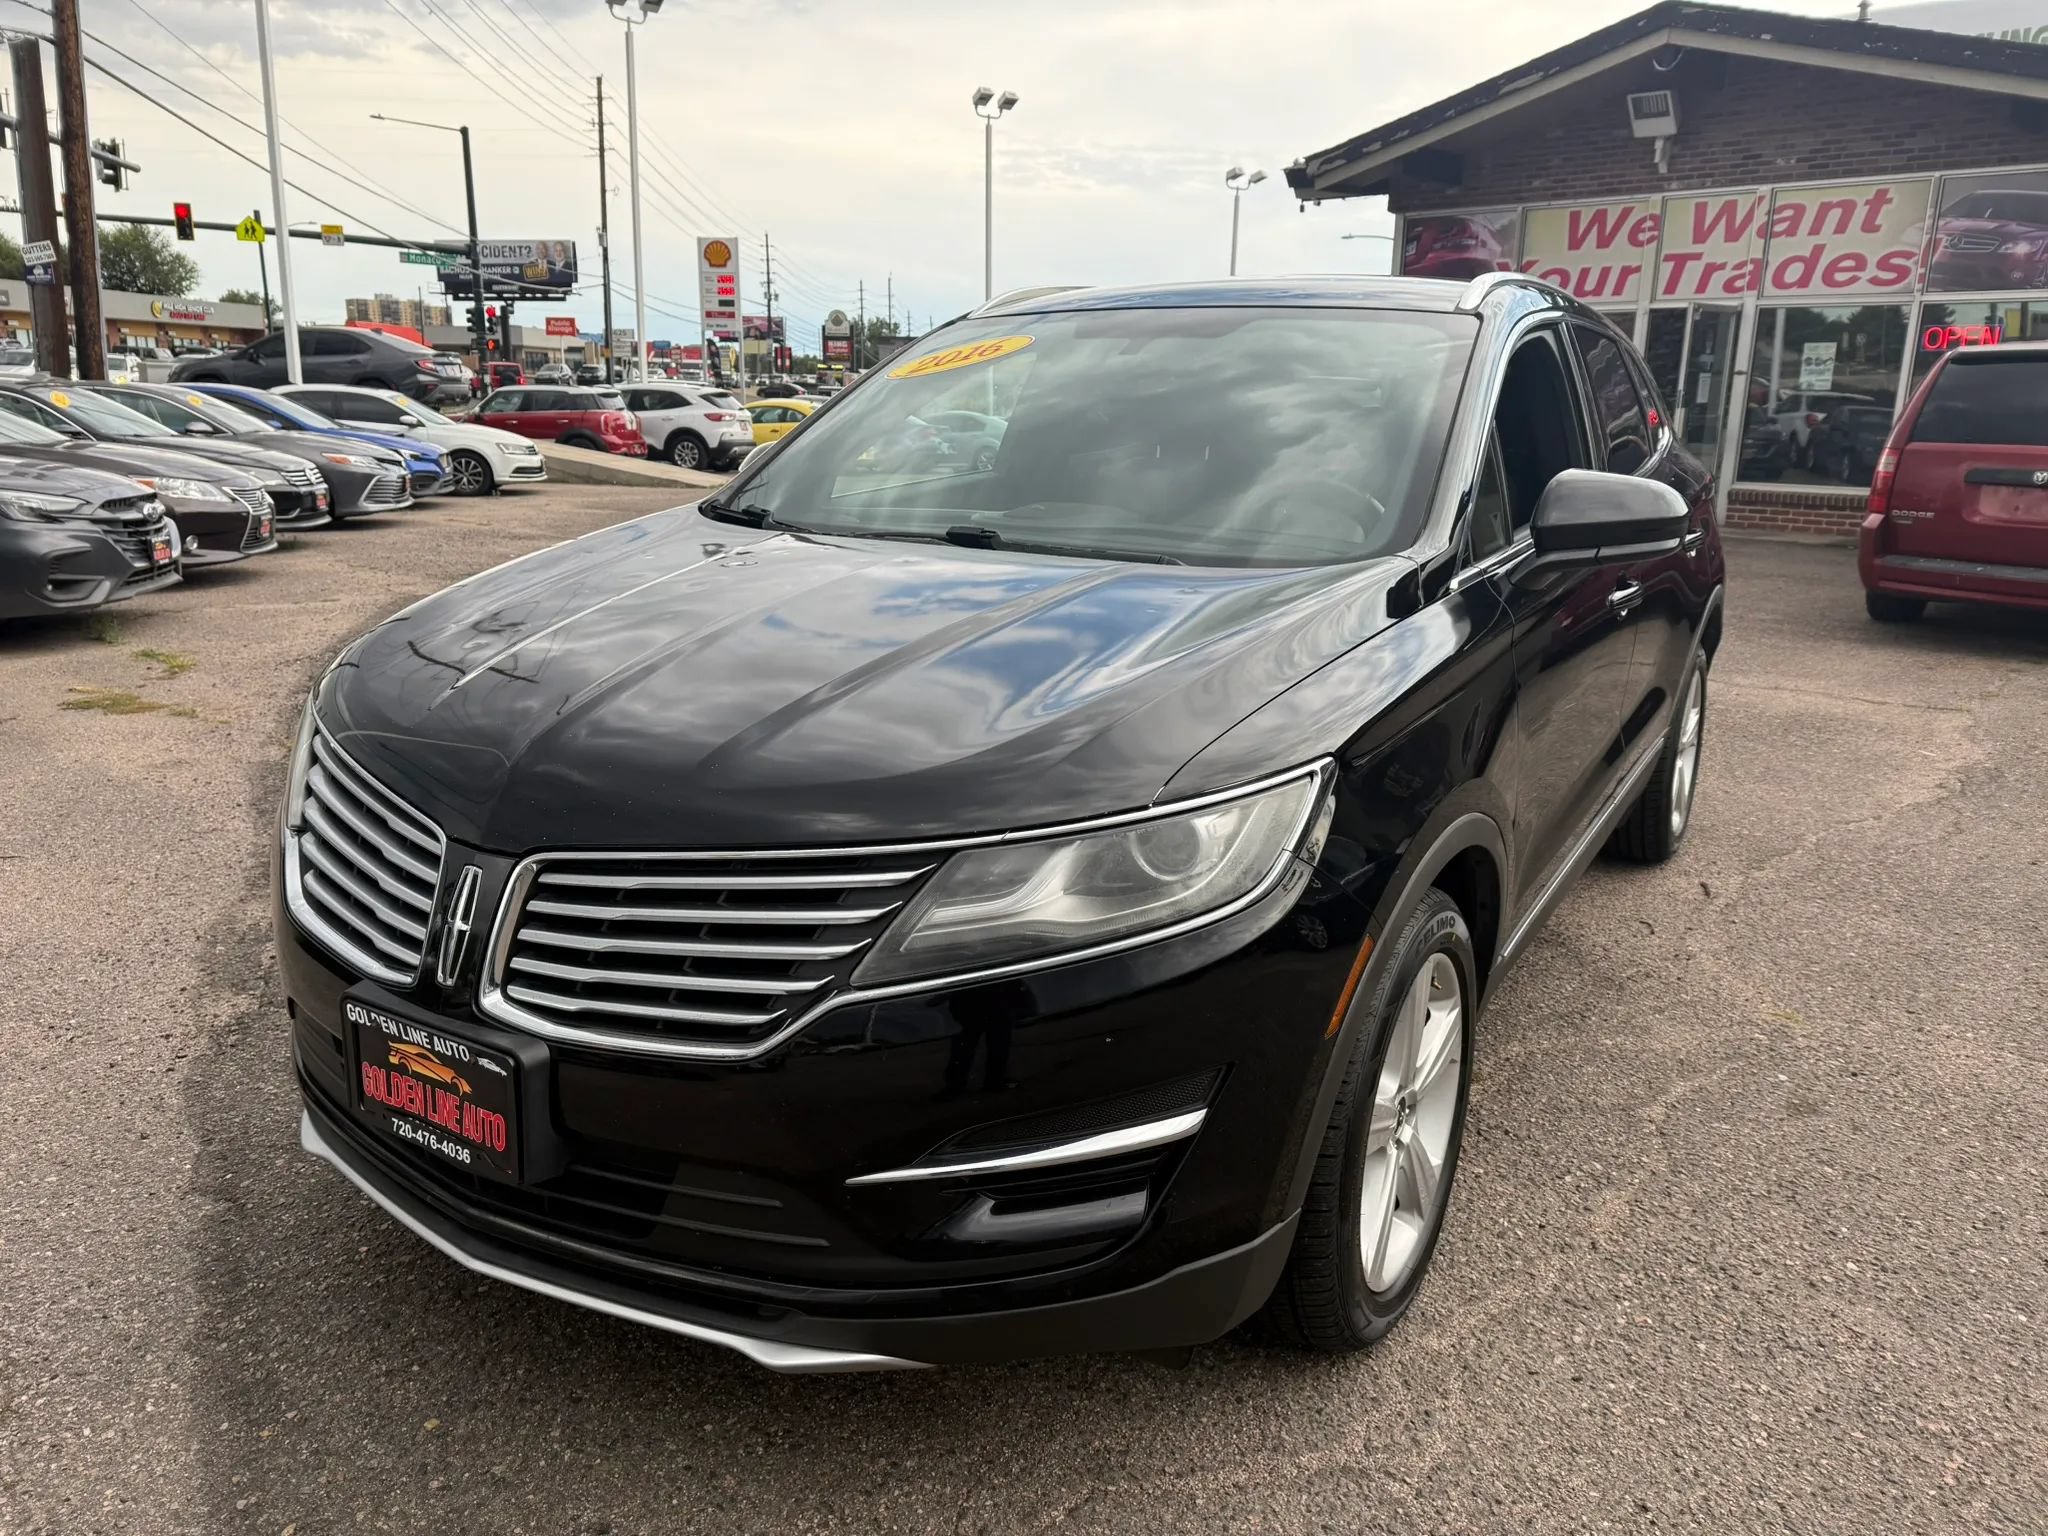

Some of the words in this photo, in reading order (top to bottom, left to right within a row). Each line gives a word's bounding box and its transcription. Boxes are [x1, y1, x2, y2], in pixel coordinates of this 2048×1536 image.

[1567, 206, 1662, 251] We
[1691, 187, 1894, 245] Want
[21, 242, 52, 255] GUTTERS
[481, 245, 532, 258] CIDENT?
[1661, 236, 1943, 295] Trades!
[906, 338, 1011, 376] 2016
[1923, 326, 2001, 350] OPEN
[1892, 509, 1936, 519] DODGE
[398, 1022, 431, 1049] LINE
[433, 1035, 470, 1063] AUTO
[361, 1060, 424, 1117] GOLDEN
[426, 1083, 461, 1134] LINE
[462, 1101, 506, 1152] AUTO
[391, 1117, 471, 1164] 720-476-4036
